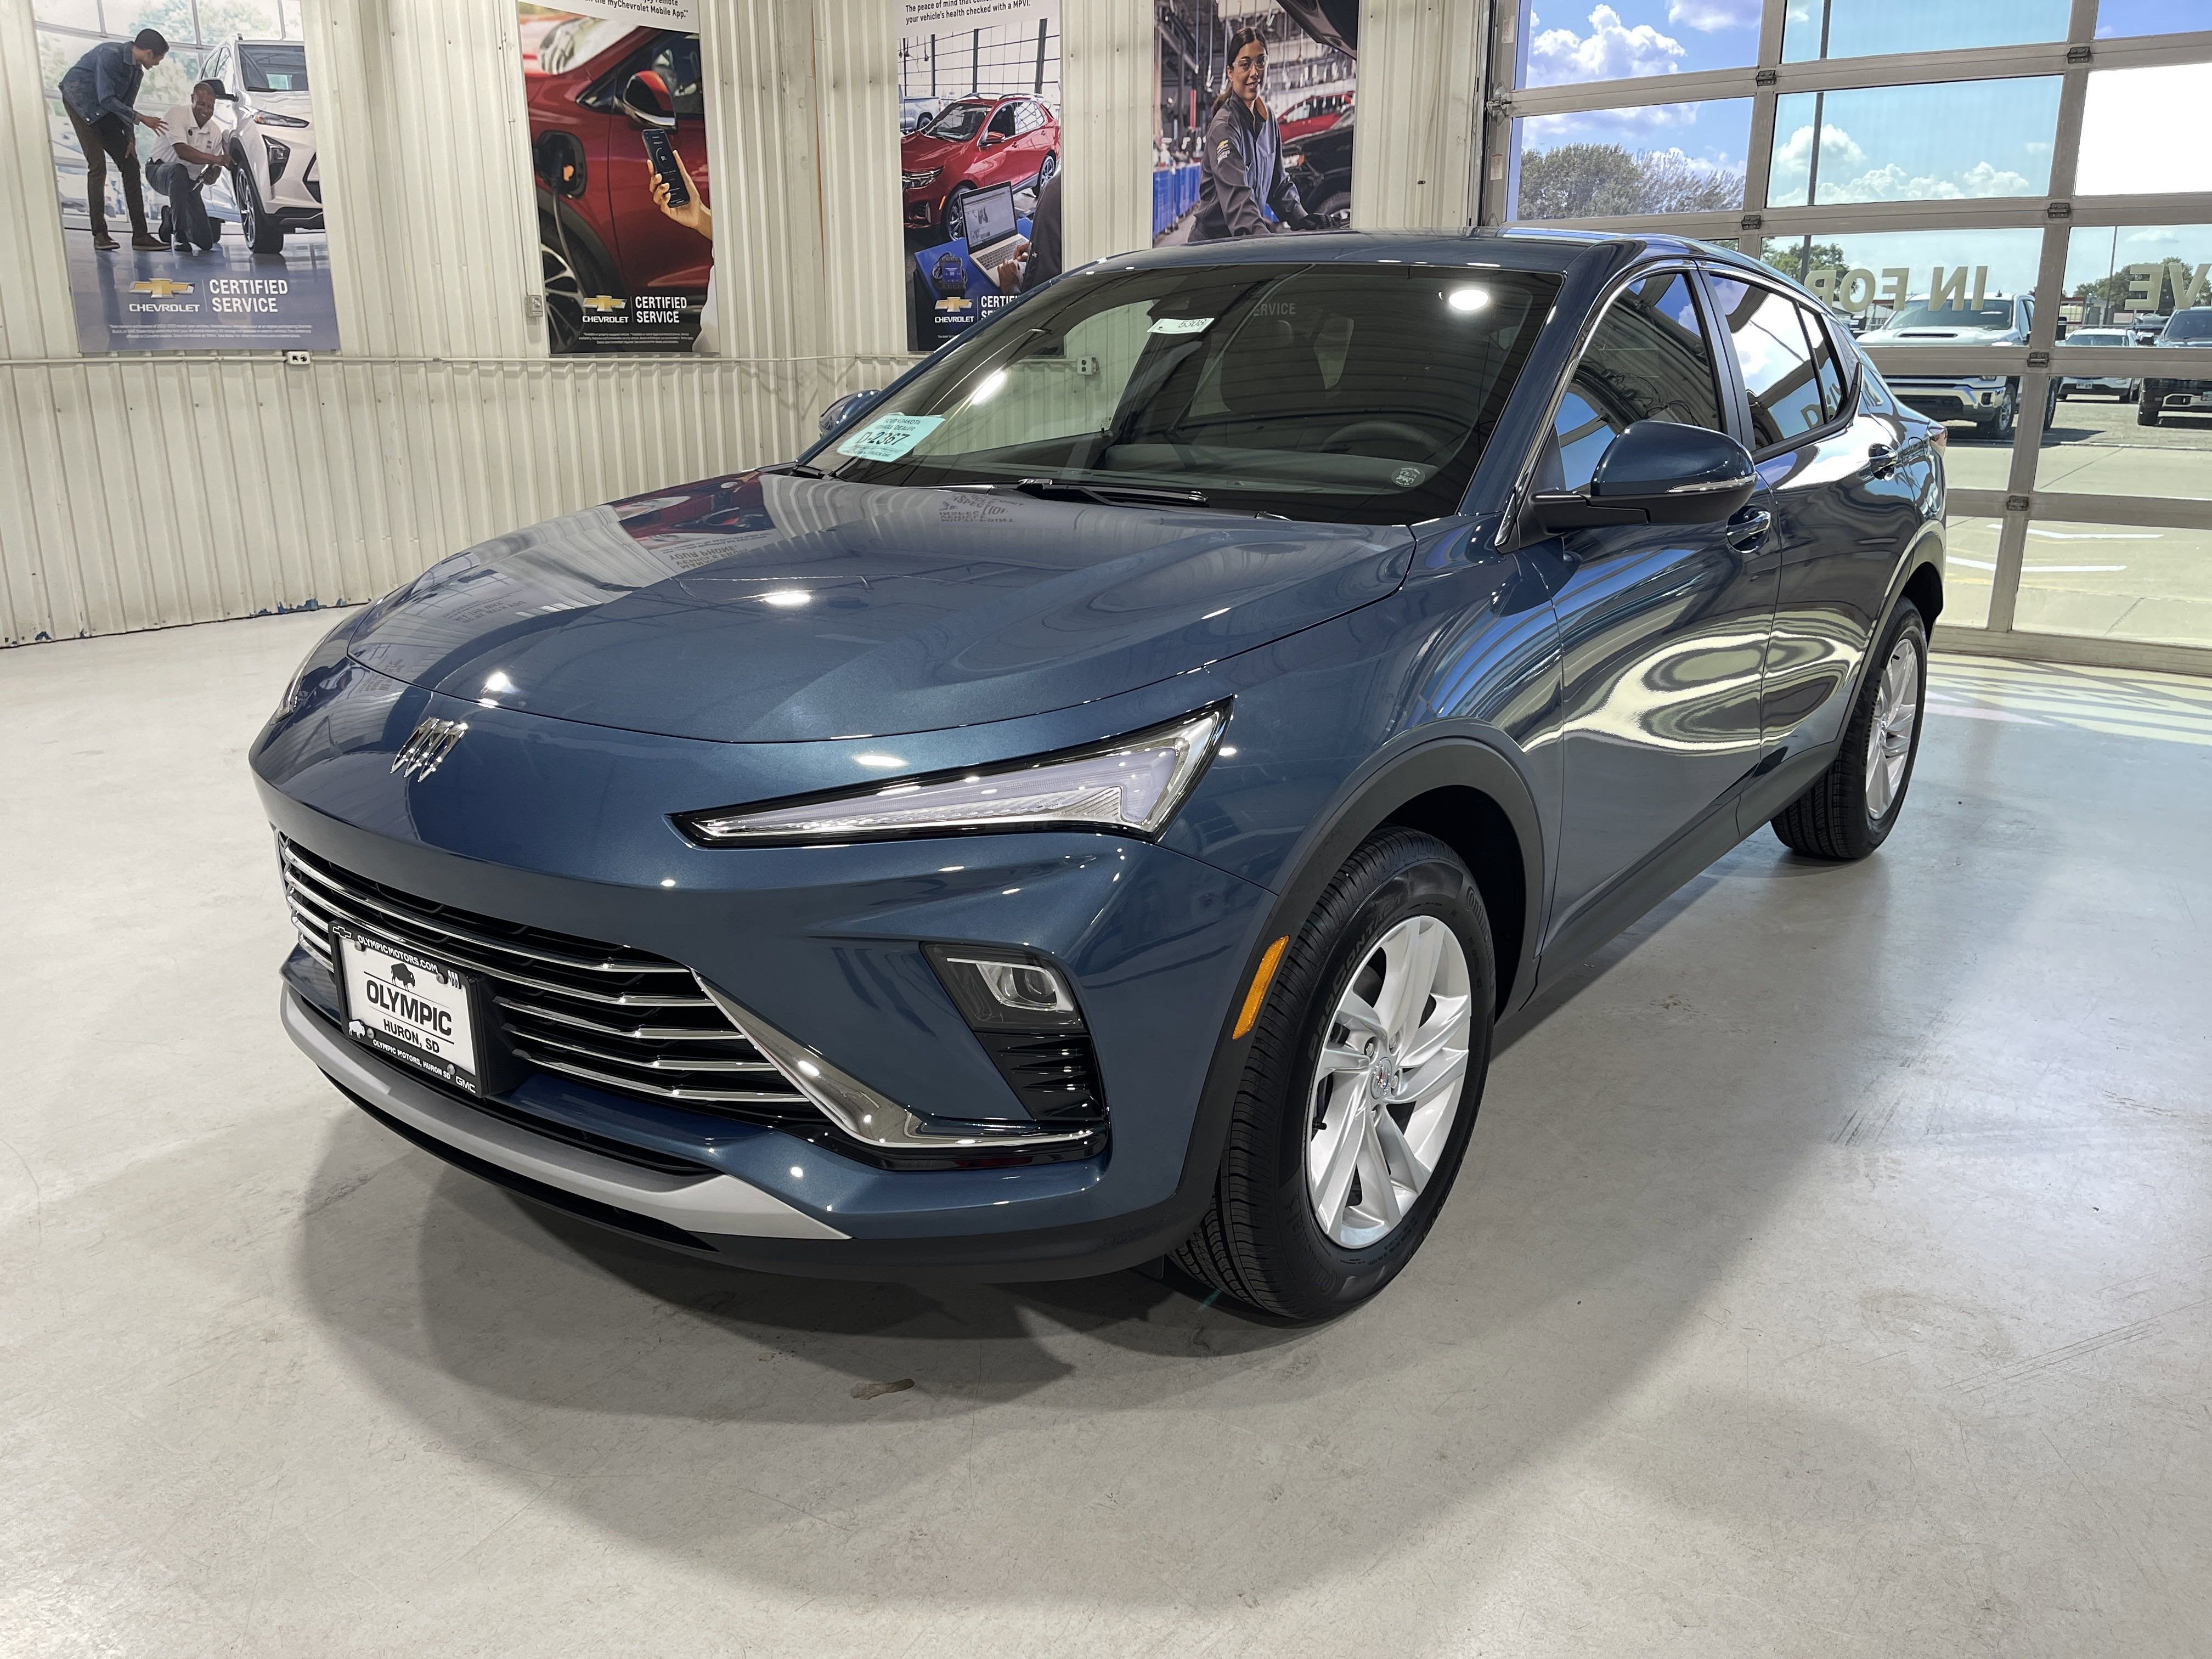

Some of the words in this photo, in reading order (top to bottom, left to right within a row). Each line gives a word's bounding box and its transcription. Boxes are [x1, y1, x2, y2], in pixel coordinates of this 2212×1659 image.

[608, 0, 648, 12] myChevrolet
[650, 5, 670, 15] Mobile
[906, 4, 916, 13] The
[918, 3, 934, 13] peace
[935, 0, 941, 8] of
[906, 16, 918, 25] your
[920, 11, 944, 21] vehicle's
[946, 8, 964, 18] health
[967, 4, 991, 15] checked
[992, 3, 1006, 12] with
[210, 279, 288, 295] CERTIFIED
[128, 303, 200, 312] CHEVROLET
[212, 297, 278, 313] SERVICE
[635, 296, 687, 309] CERTIFIED
[636, 311, 680, 323] SERVICE
[1178, 319, 1207, 328] 5308
[856, 431, 911, 445] D-2367
[357, 934, 438, 973] OLYMPICMOTORS.COM
[366, 979, 452, 1037] OLYMPIC
[383, 1018, 422, 1048] HURON,
[425, 1037, 440, 1053] SD
[373, 1039, 396, 1054] OLYMPIC
[397, 1049, 422, 1067] MOTORS,
[422, 1060, 443, 1077] HURON
[443, 1069, 451, 1080] SD
[455, 1075, 476, 1093] GMC
